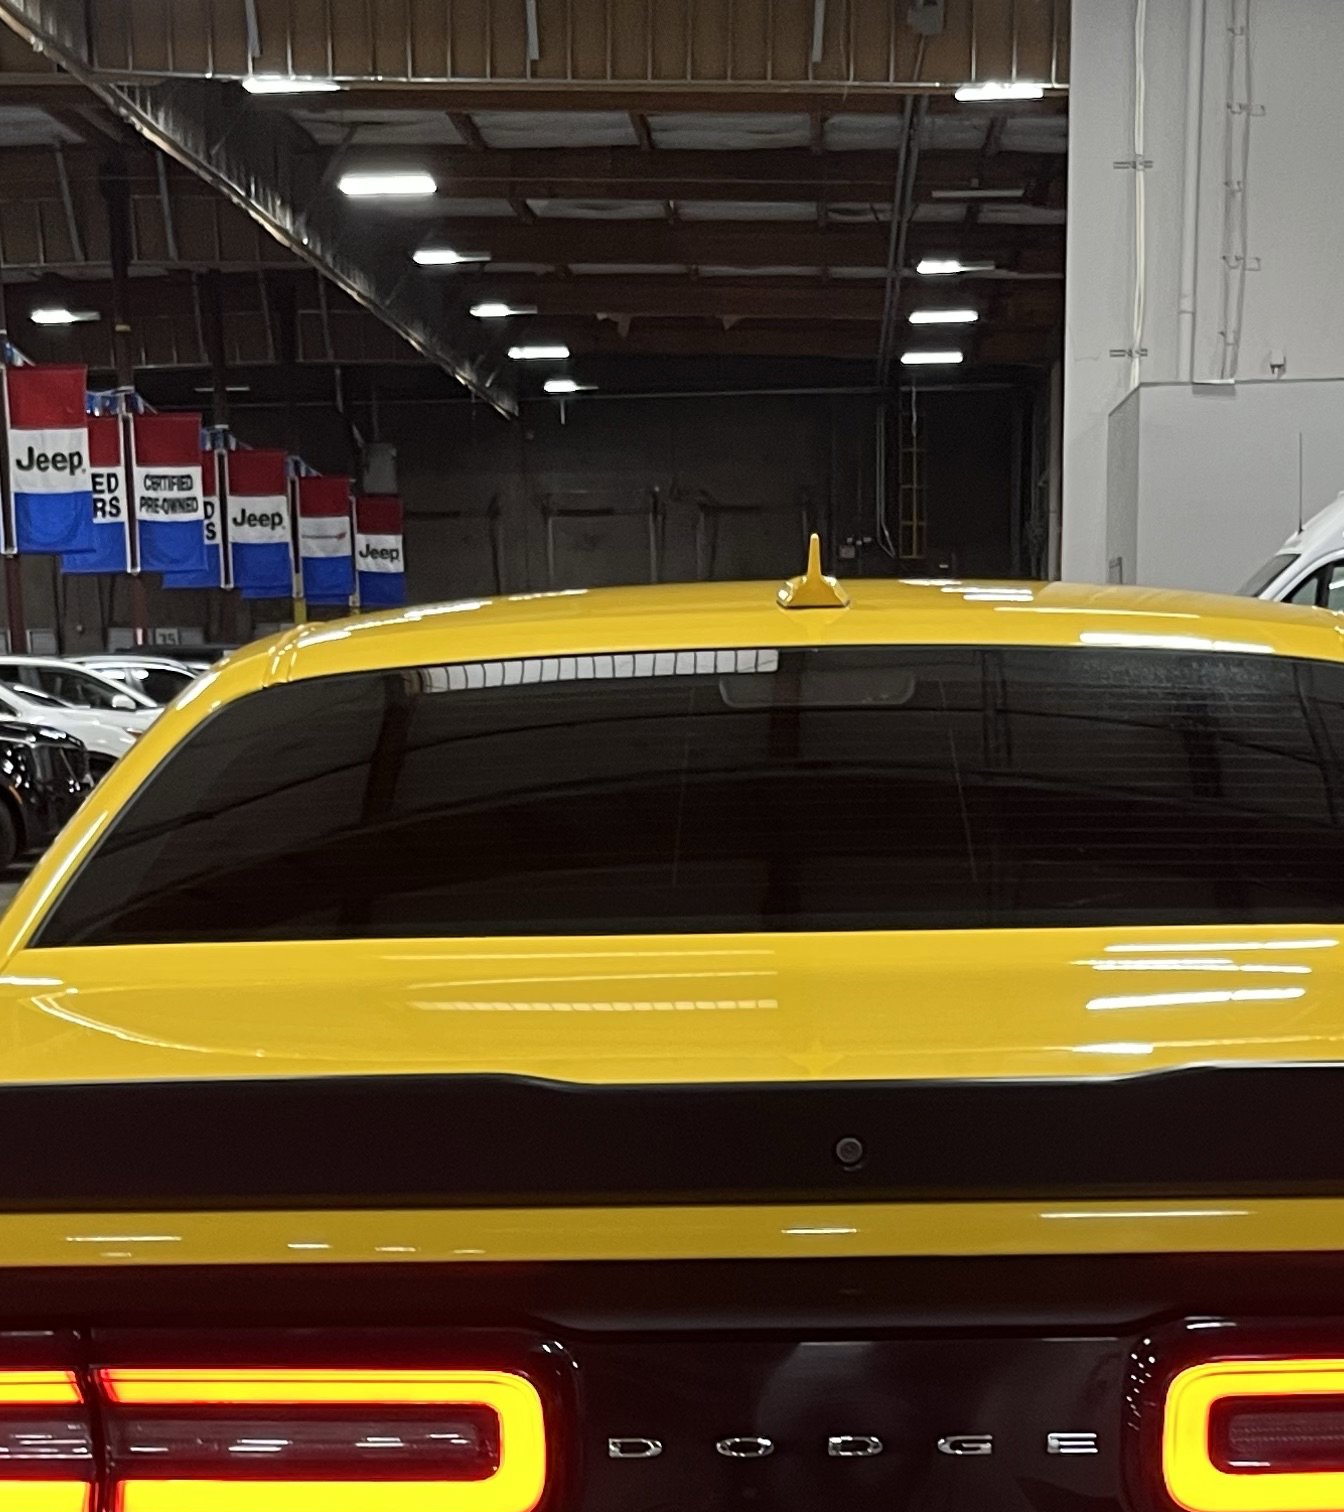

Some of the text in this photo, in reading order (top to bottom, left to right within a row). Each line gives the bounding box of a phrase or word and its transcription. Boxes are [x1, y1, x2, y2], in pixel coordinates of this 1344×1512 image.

[15, 446, 83, 476] Jeep
[91, 473, 119, 494] ED
[143, 473, 193, 492] CERTIFIED
[93, 497, 121, 519] RS
[139, 496, 199, 515] PRE-OWNED
[232, 508, 283, 531] Jeep
[358, 543, 400, 562] Jeep
[608, 1432, 1099, 1459] DODGE
